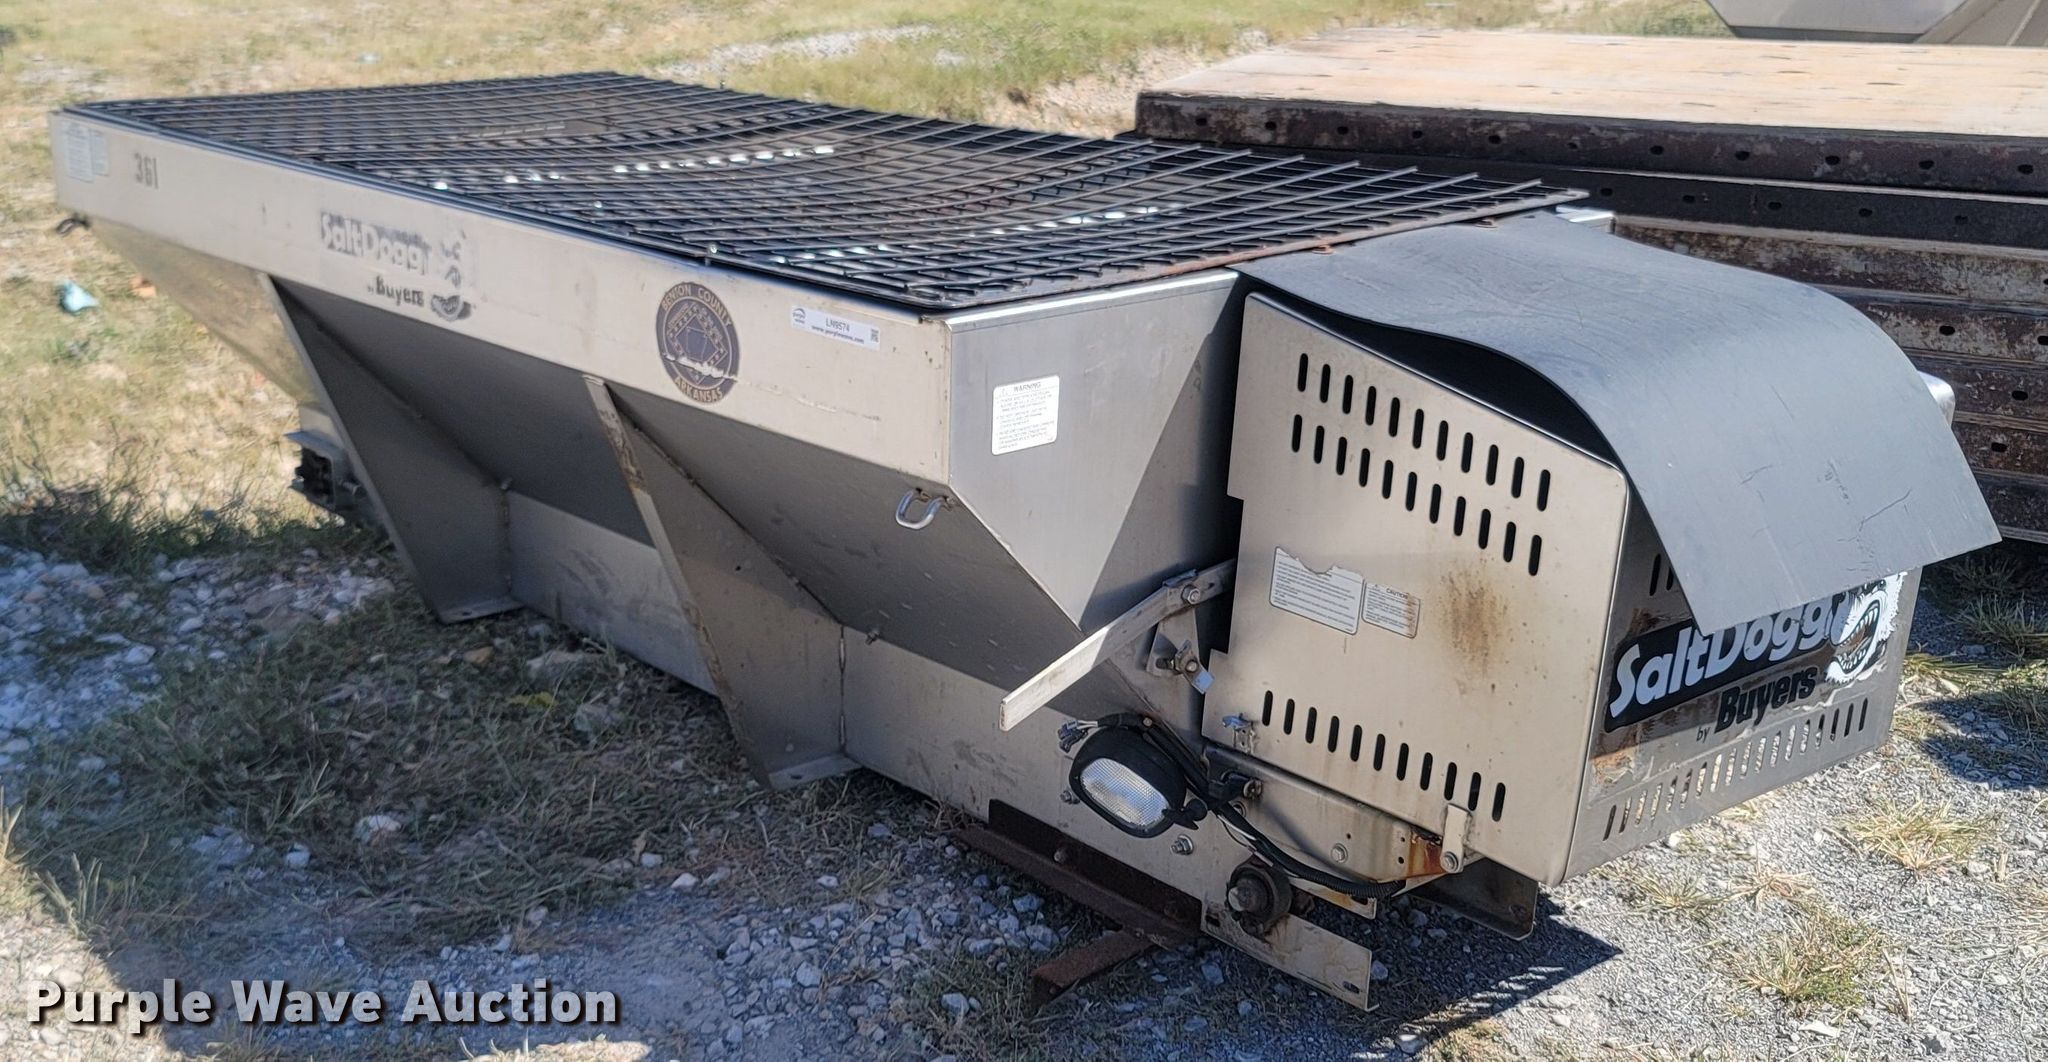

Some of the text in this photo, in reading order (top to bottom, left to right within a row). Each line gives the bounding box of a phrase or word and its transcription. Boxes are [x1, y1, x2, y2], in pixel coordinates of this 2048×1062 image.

[376, 275, 424, 307] Buyers
[661, 284, 692, 311] BENTON
[697, 287, 731, 327] COUNTY
[675, 376, 723, 402] ARKANSAS
[1696, 666, 1818, 742] by Buyers
